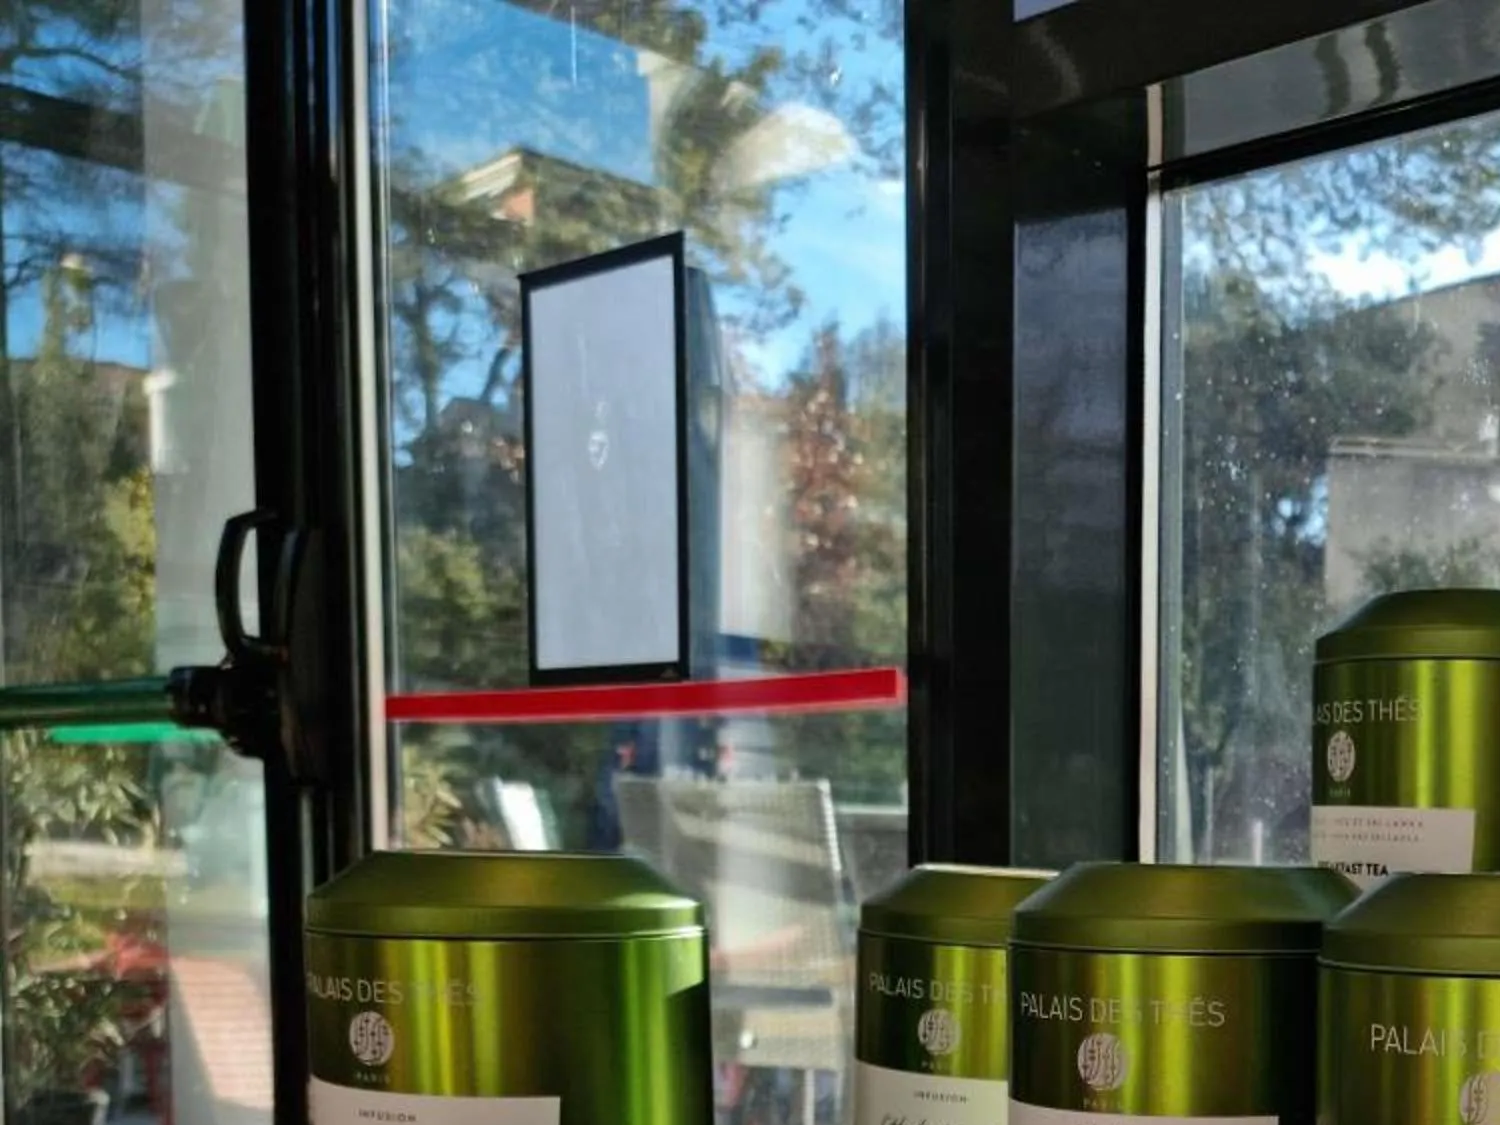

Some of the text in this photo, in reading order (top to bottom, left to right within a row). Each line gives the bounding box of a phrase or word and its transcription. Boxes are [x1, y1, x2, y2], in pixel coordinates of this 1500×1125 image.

[1332, 701, 1363, 723] DES
[1367, 694, 1424, 722] THÉS
[1366, 862, 1389, 877] TEA
[357, 979, 404, 1005] DES
[1020, 991, 1084, 1022] PALAIS
